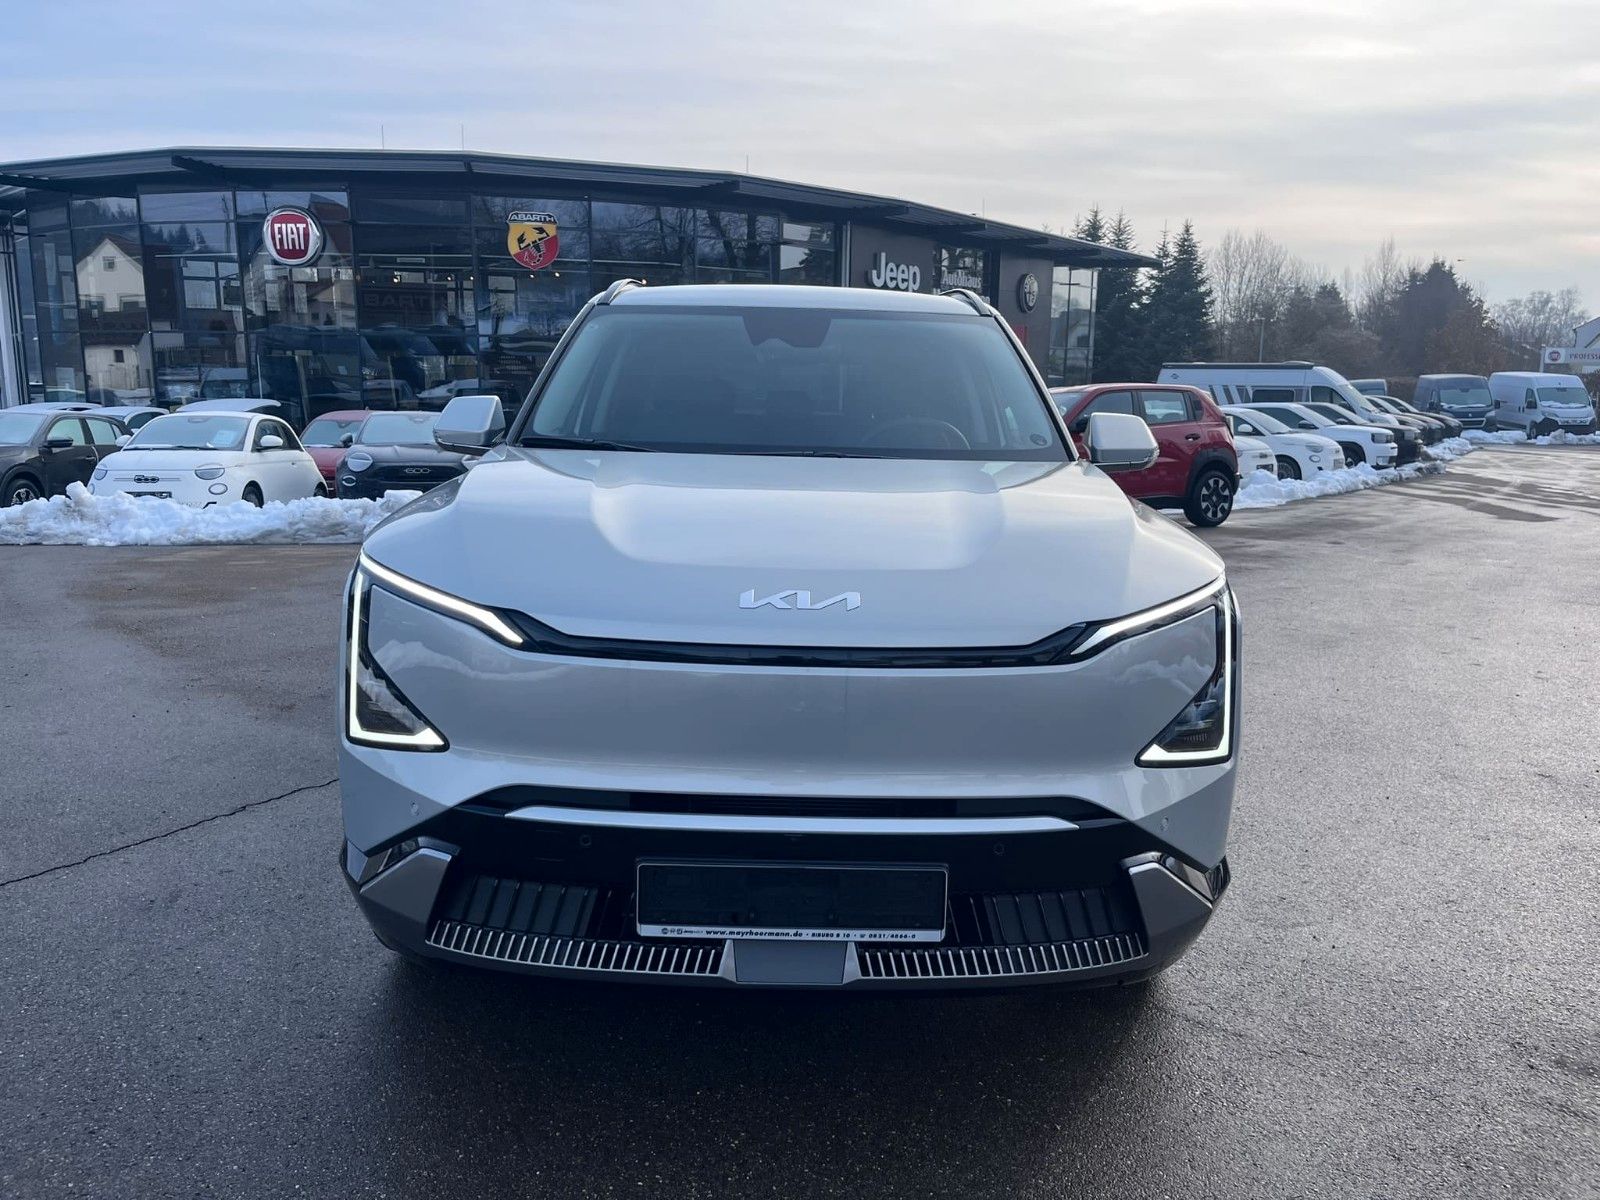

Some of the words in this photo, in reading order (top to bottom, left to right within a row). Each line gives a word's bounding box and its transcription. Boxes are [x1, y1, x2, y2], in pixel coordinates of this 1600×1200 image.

[511, 213, 554, 222] ABARTH
[273, 223, 306, 250] FIAT
[872, 252, 921, 292] Jeep
[941, 269, 982, 289] Autohaus
[739, 589, 861, 611] KIA
[705, 929, 803, 938] www.mayrhoermann.de
